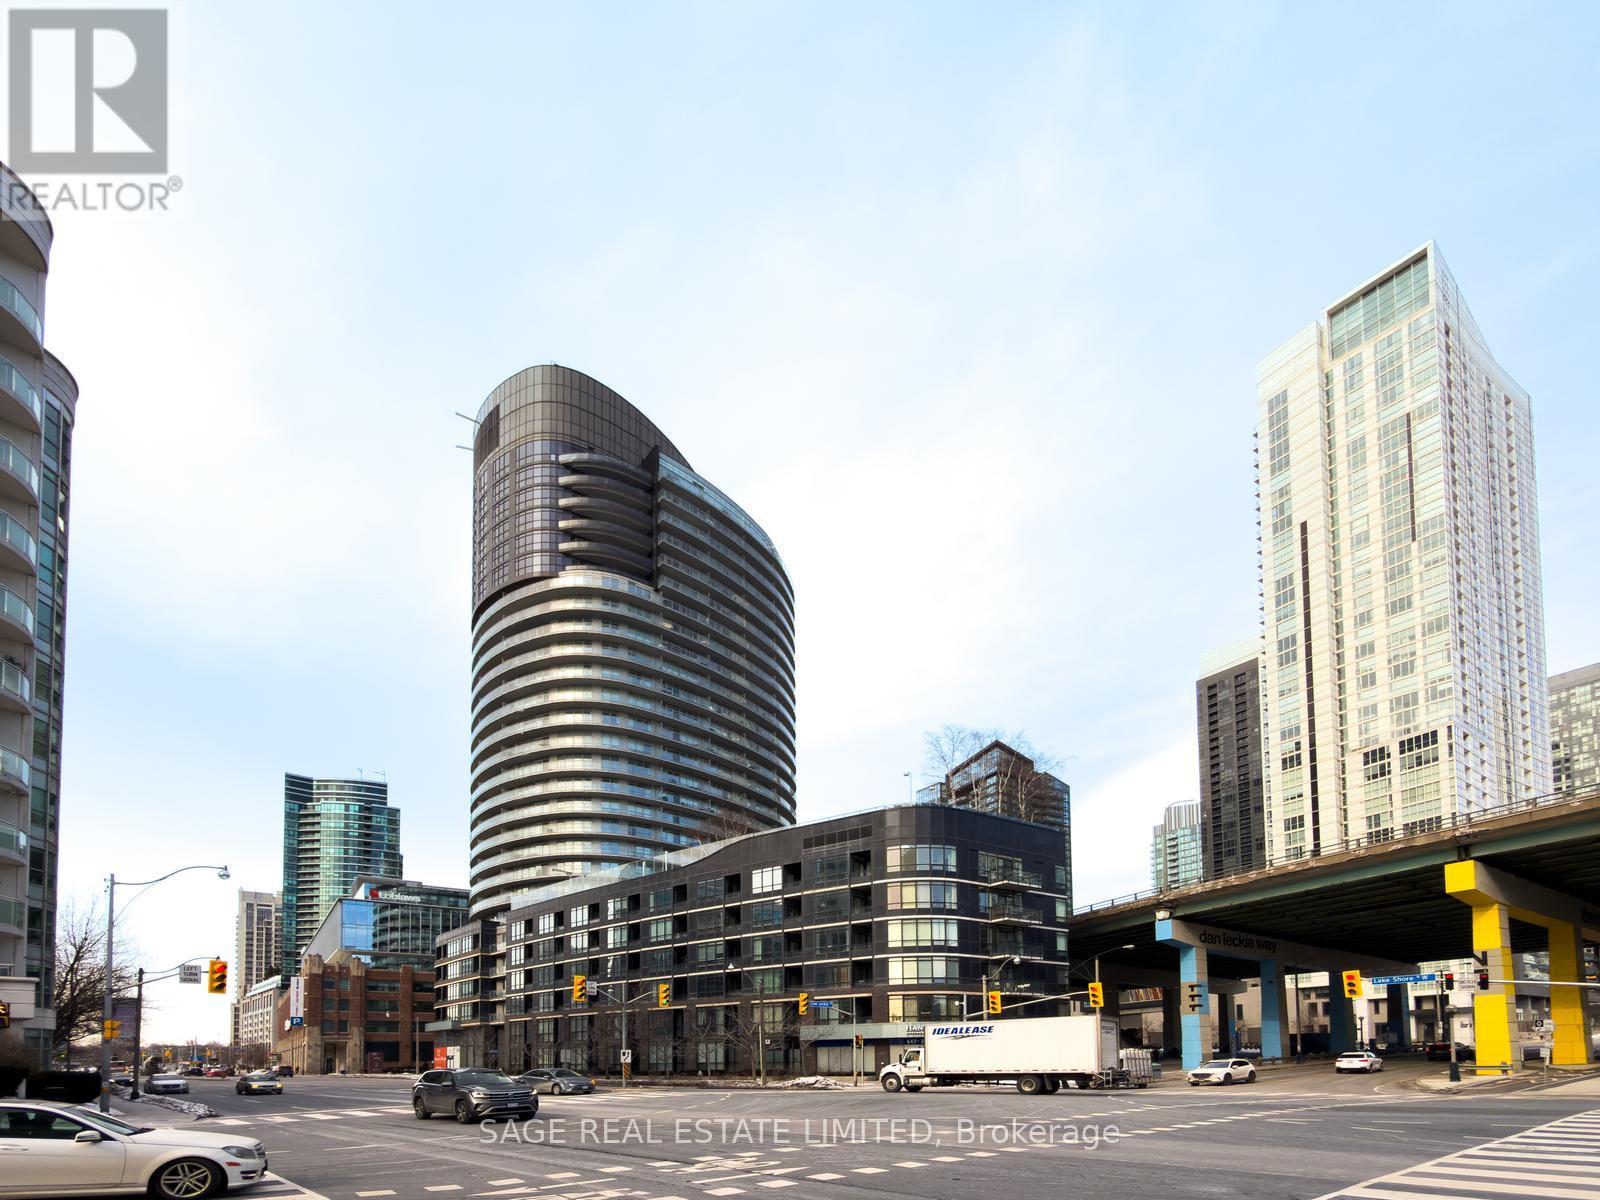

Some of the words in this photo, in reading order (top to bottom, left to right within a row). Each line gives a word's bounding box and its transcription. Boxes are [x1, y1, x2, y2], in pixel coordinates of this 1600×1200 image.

[1199, 929, 1221, 945] dan
[1222, 932, 1254, 949] leckie
[1256, 939, 1278, 954] way
[1373, 976, 1390, 984] Lake
[1393, 975, 1414, 983] Shore
[293, 1017, 301, 1025] P
[932, 1025, 995, 1036] IDEALEASE
